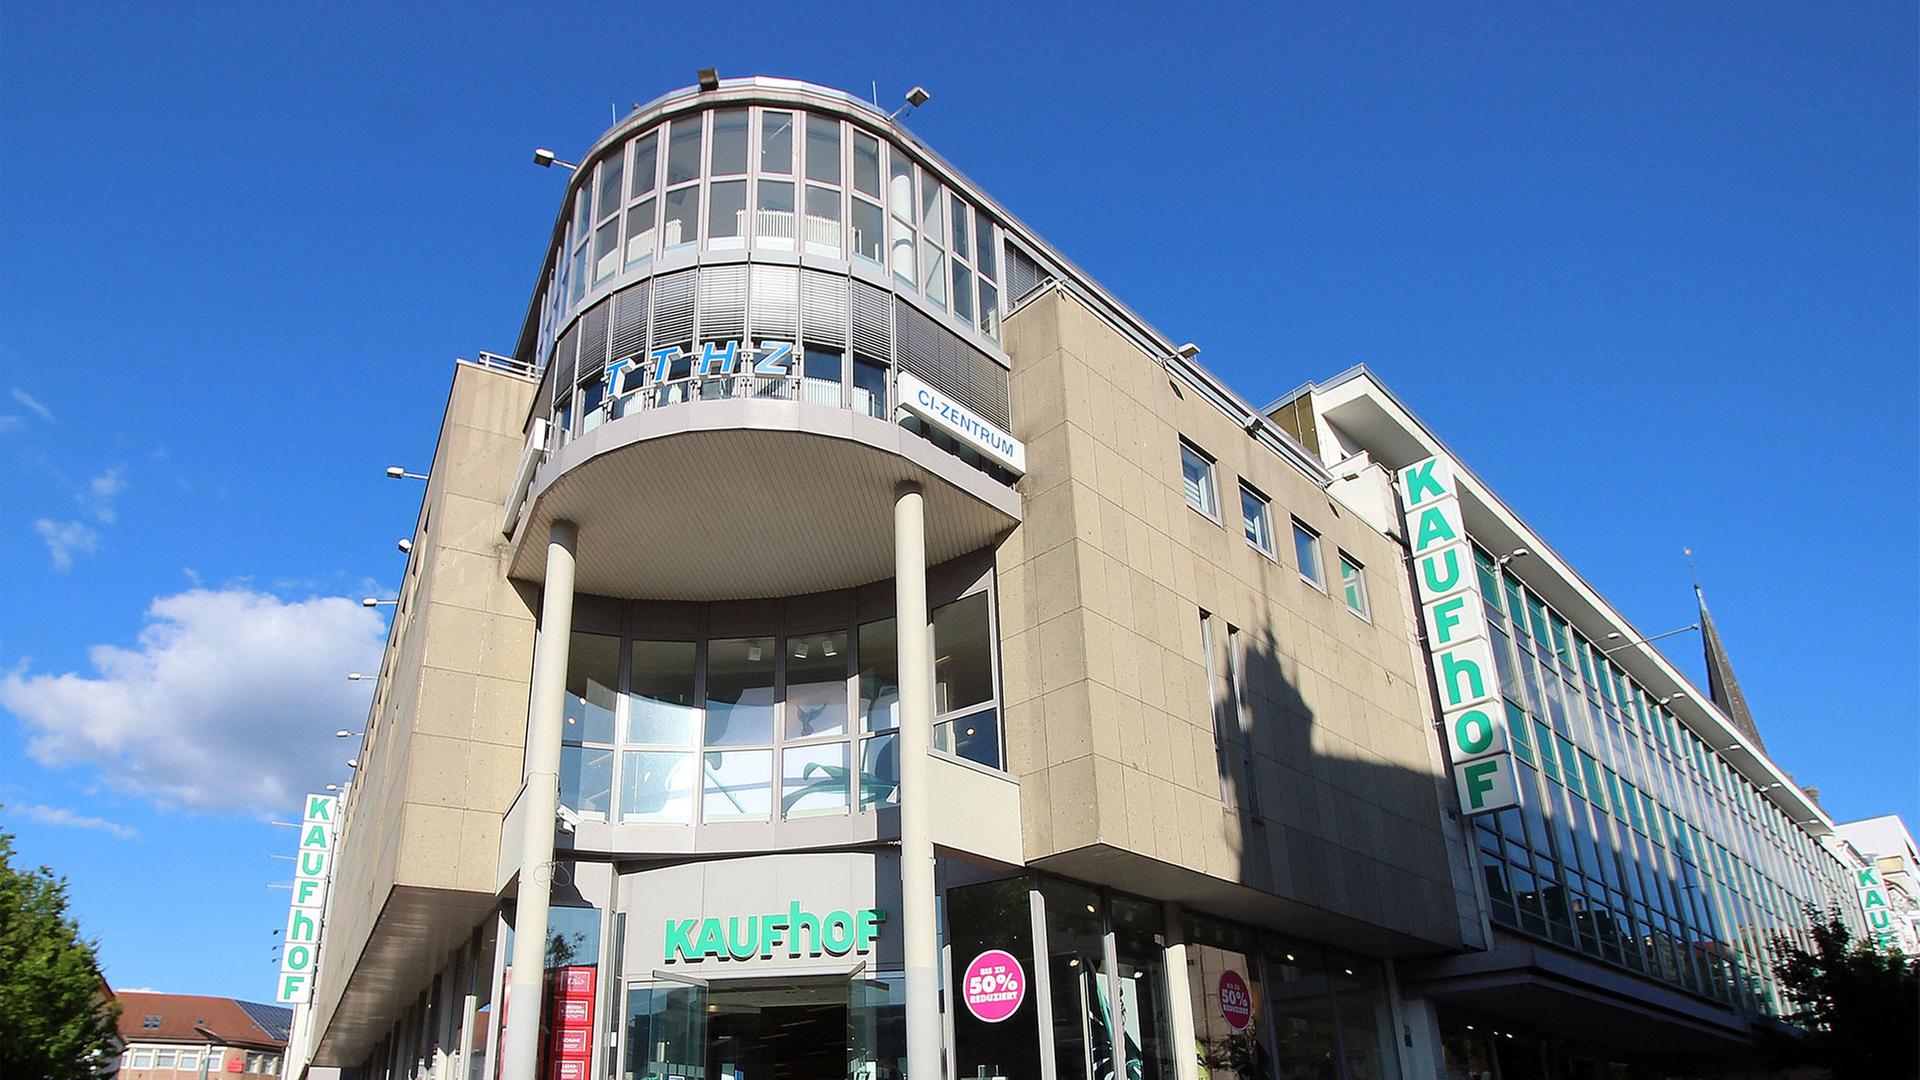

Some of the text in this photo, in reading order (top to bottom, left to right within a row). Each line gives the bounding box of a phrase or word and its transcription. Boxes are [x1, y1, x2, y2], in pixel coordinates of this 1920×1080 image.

[918, 389, 1014, 458] CI-ZENTRUM
[1405, 457, 1498, 810] KAUFhoF
[283, 796, 330, 1000] KAUFhoF
[664, 899, 886, 965] KAUFhoF
[969, 972, 1019, 995] 50%
[980, 965, 1006, 975] BIS ZU
[969, 991, 1018, 1004] REDUZIERT
[1221, 988, 1249, 1007] 50%
